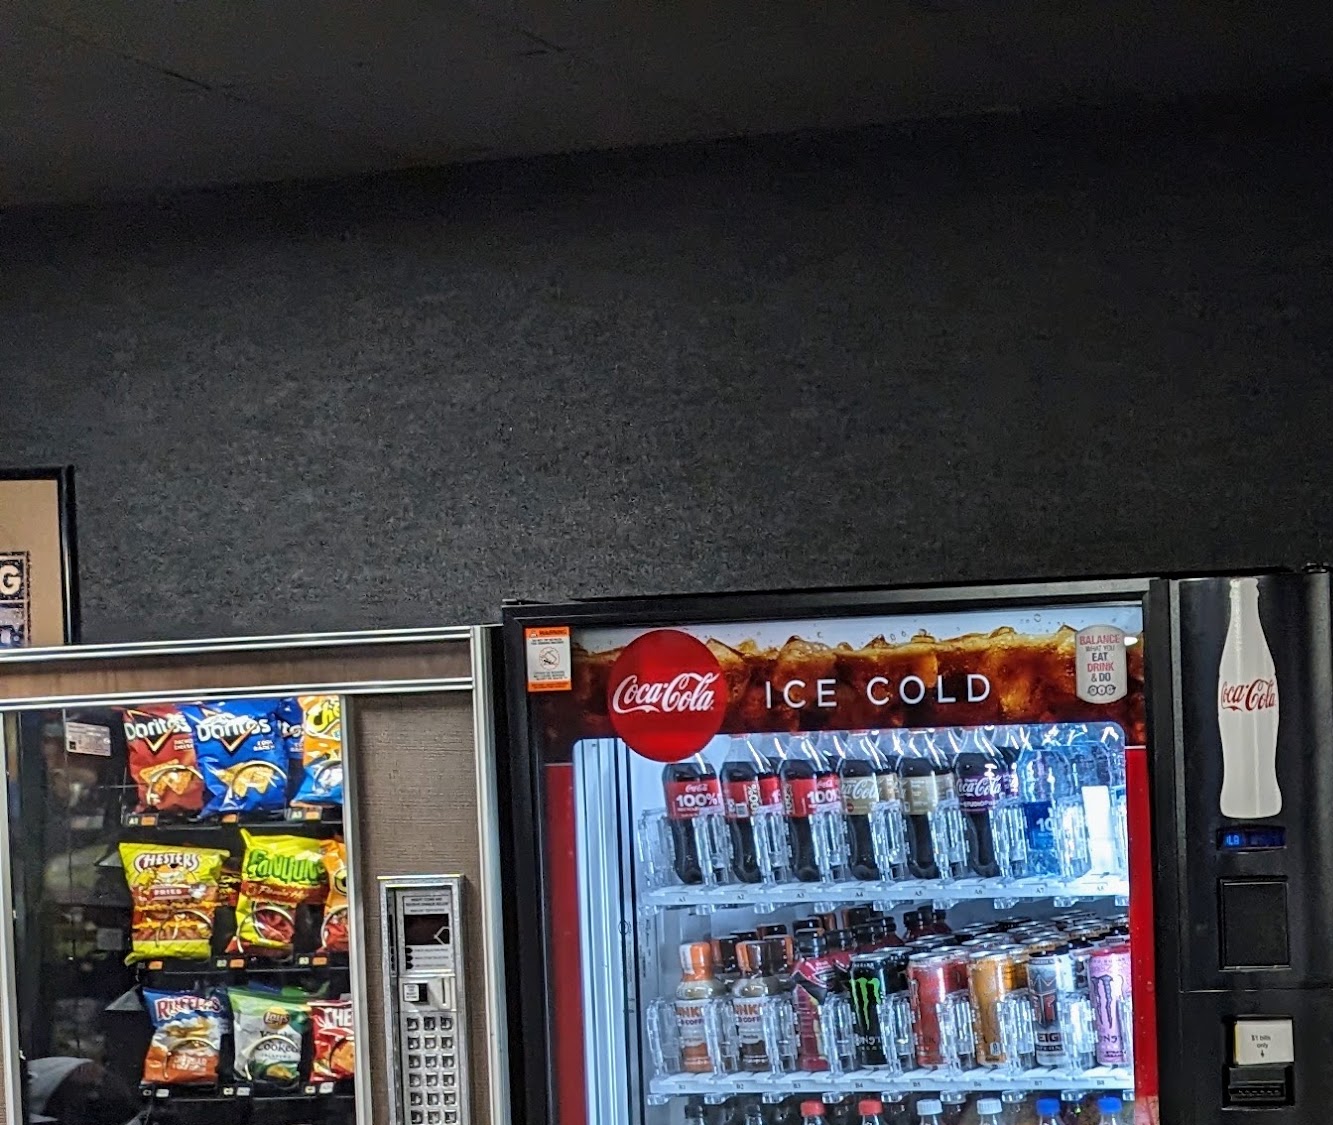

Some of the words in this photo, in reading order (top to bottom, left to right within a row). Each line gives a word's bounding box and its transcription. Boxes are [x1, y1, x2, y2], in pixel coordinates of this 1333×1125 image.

[1079, 634, 1121, 646] BALANCE
[1092, 652, 1108, 662] EAT
[1087, 662, 1114, 673] DRINK
[1091, 673, 1097, 683] &
[1099, 672, 1111, 682] DO
[612, 672, 720, 714] Coca-Cola
[765, 680, 837, 708] ICE
[866, 672, 991, 705] COLD
[196, 717, 272, 743] Doritos
[675, 793, 717, 807] 100%
